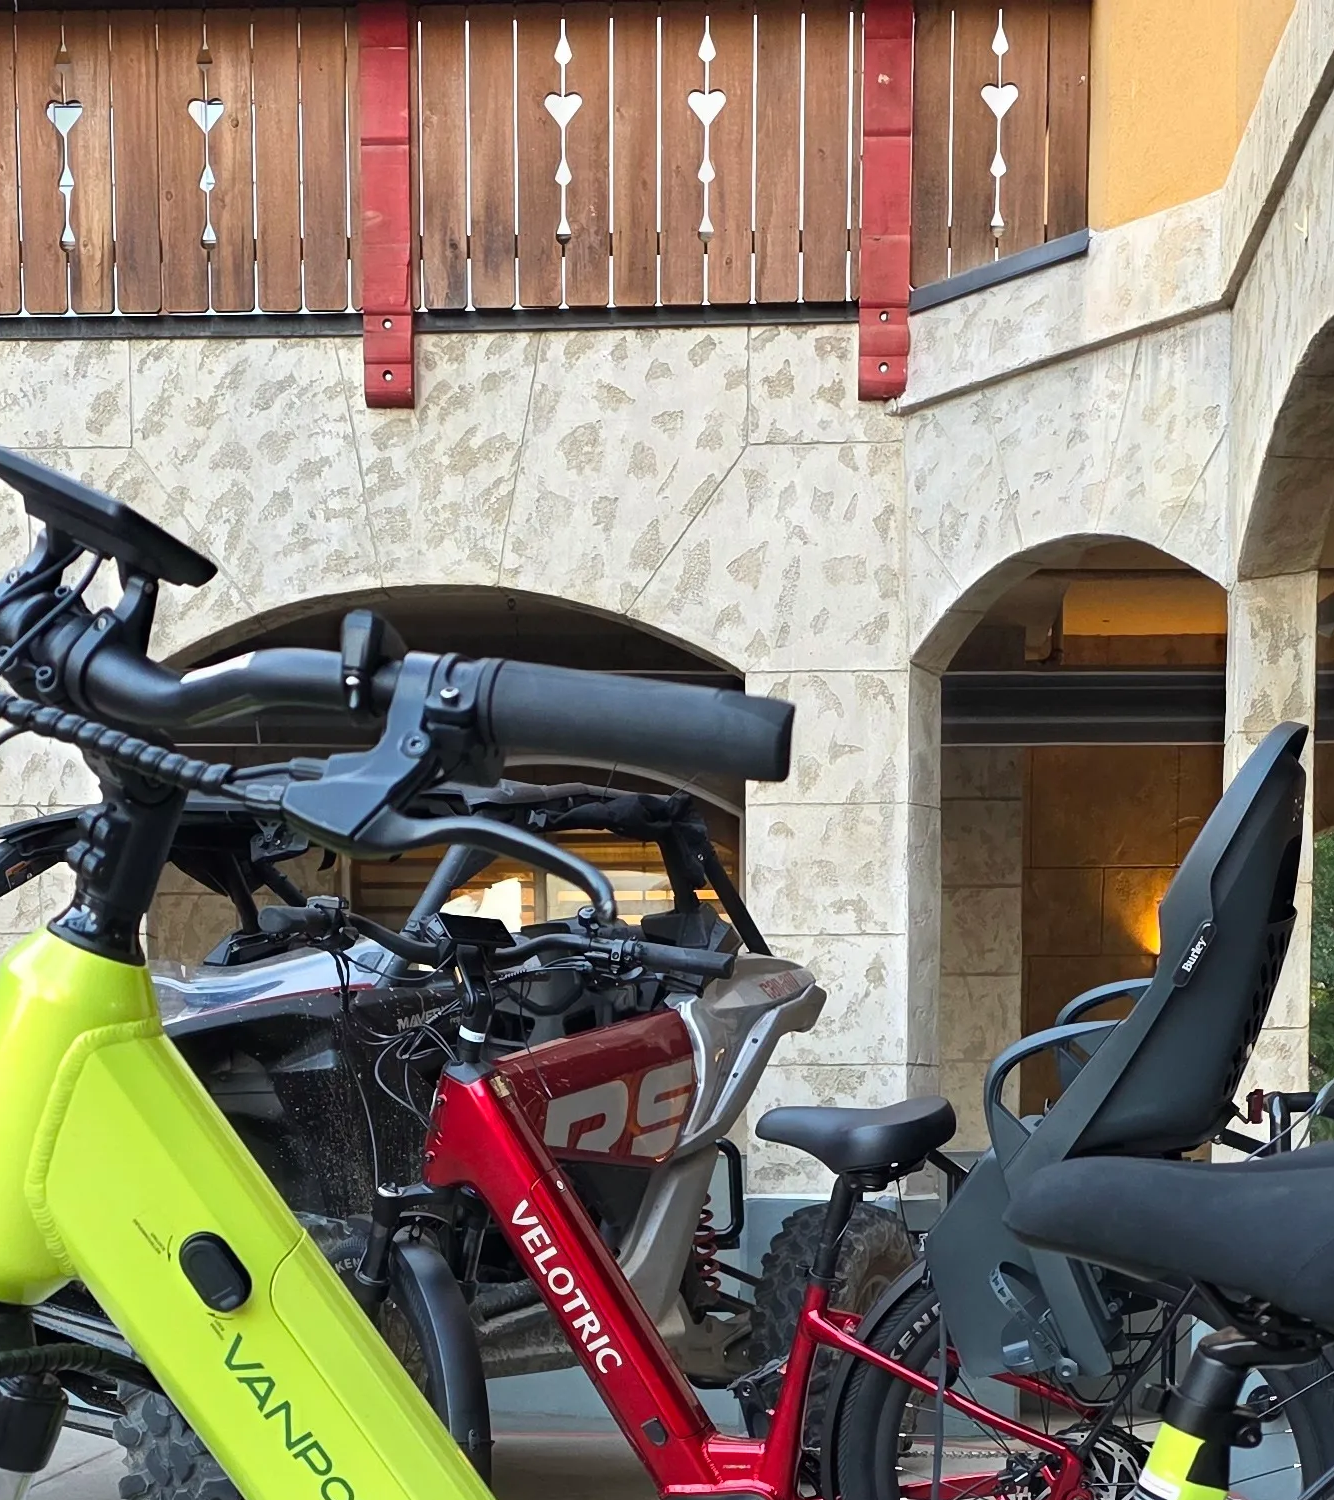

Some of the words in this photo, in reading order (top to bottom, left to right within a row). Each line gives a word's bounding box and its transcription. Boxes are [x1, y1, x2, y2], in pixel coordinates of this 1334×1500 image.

[1182, 936, 1207, 972] Burley
[544, 1059, 693, 1158] RS
[511, 1199, 623, 1374] VELOTRIC
